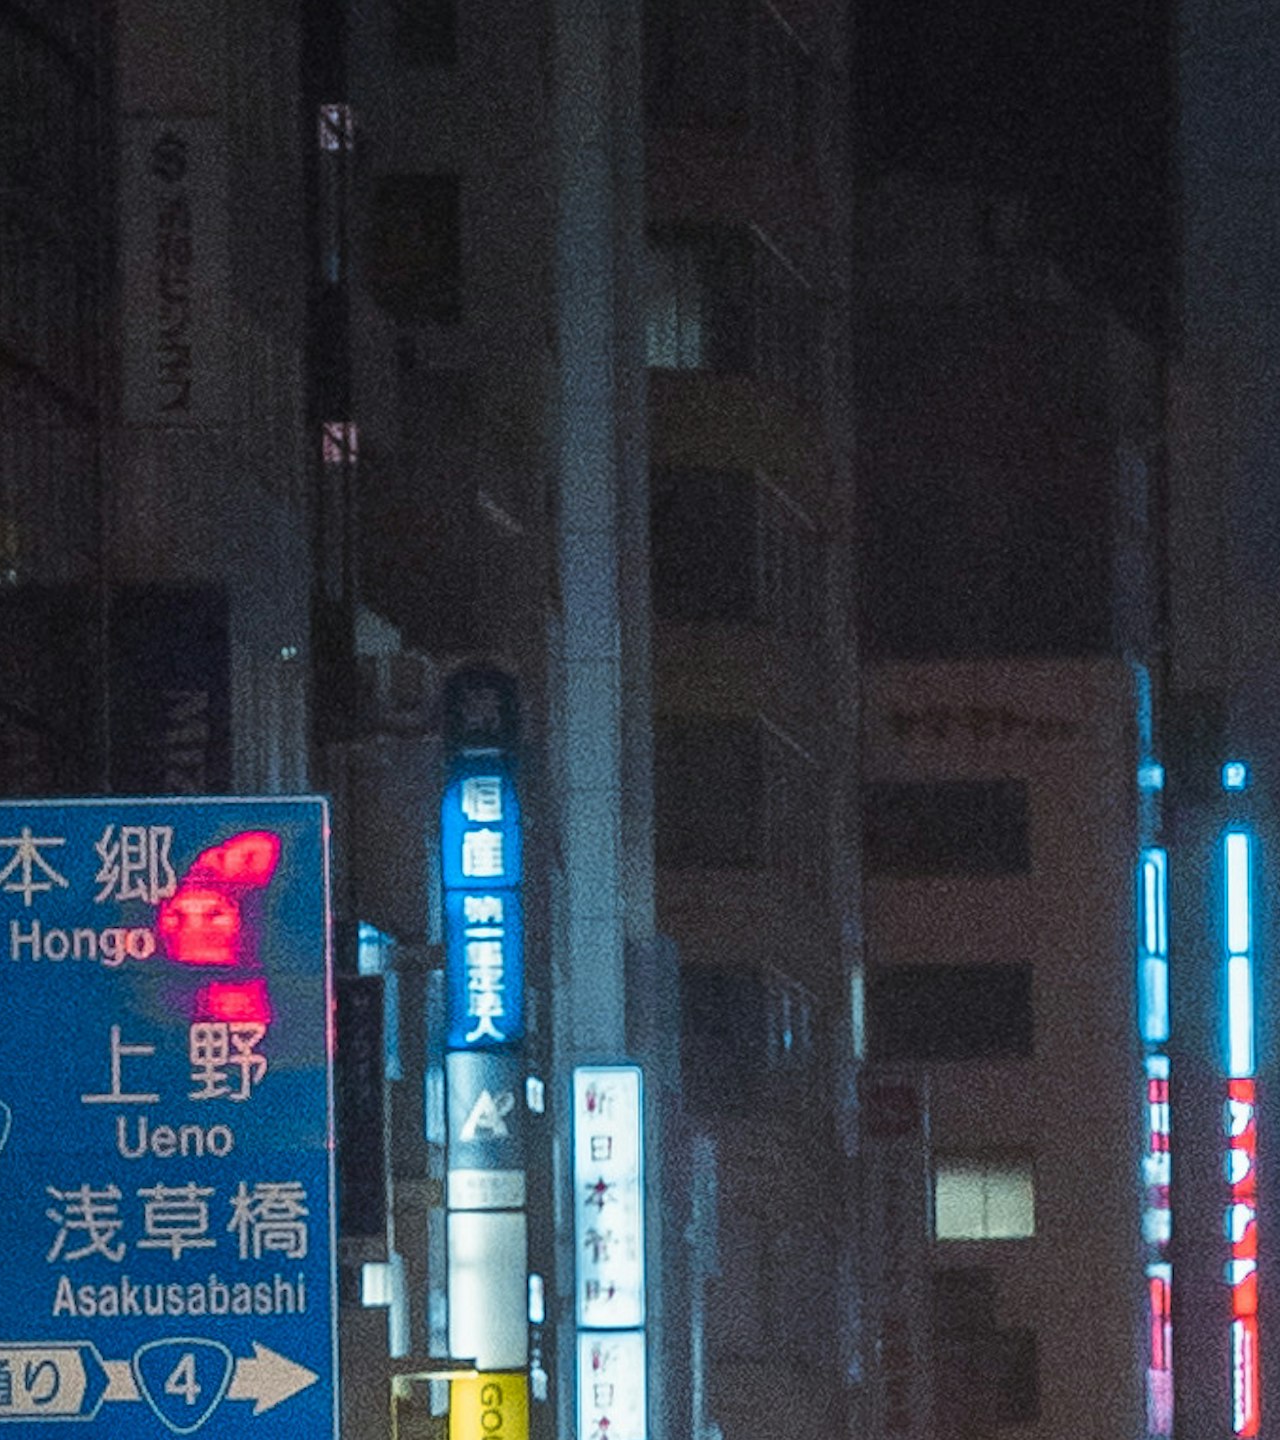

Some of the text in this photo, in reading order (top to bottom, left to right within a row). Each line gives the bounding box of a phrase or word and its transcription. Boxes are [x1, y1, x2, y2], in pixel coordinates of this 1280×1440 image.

[11, 920, 154, 968] Hongo
[80, 1024, 268, 1104] 上野
[116, 1124, 233, 1158] Ueno
[46, 1183, 309, 1263] 浅草橋
[54, 1273, 307, 1318] Asakusabashi
[165, 1355, 200, 1405] 4
